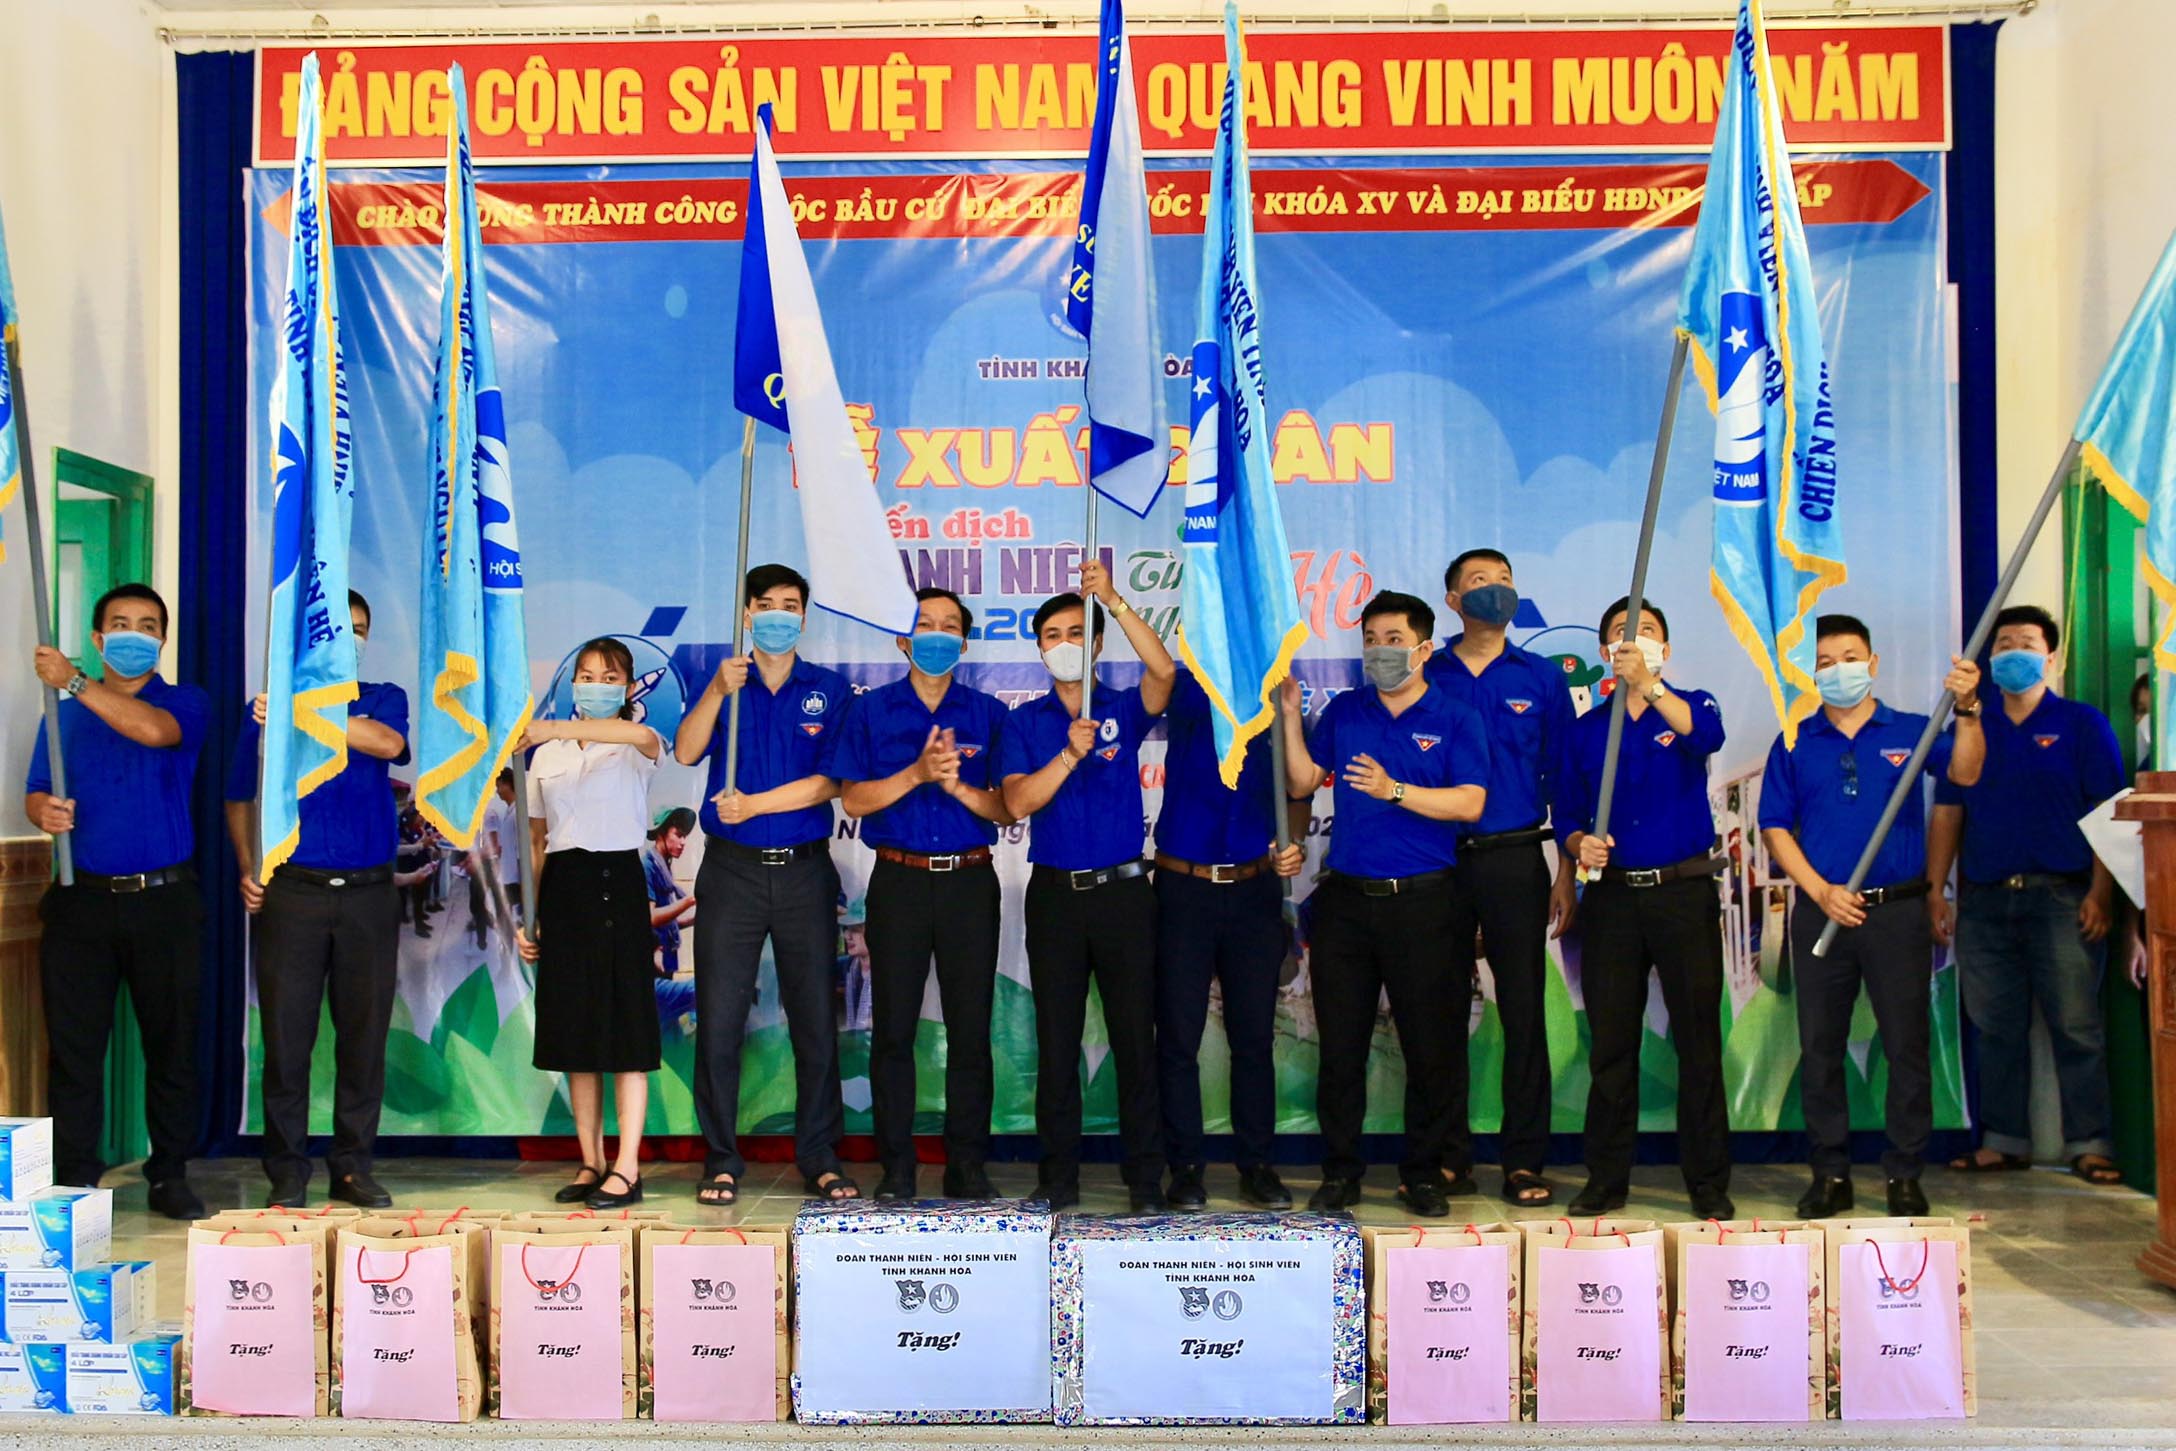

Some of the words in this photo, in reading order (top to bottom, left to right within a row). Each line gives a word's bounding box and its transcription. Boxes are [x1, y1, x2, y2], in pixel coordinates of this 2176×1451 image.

[475, 54, 643, 147] CỘNG
[668, 45, 797, 135] SẢN
[821, 52, 951, 142] VIỆT
[1147, 60, 1362, 138] QUANG
[1382, 59, 1532, 127] VINH
[1552, 42, 1731, 125] MUÔN
[1770, 41, 1919, 122] NĂM
[356, 198, 438, 229] CHÀO
[543, 197, 647, 227] THÀNH
[655, 194, 738, 225] CÔNG
[789, 194, 827, 228] ỘC
[834, 187, 898, 222] BẦU
[1147, 183, 1191, 217] ỐC
[1264, 185, 1348, 215] KHÓA
[1356, 191, 1399, 214] XV
[1407, 184, 1448, 213] VÀ
[1456, 189, 1513, 220] ĐẠI
[1796, 173, 1833, 207] ẤP
[1164, 354, 1193, 376] ÒA
[1792, 435, 1837, 523] CHIẾN
[942, 509, 1031, 546] dịch
[489, 559, 514, 578] HỘI
[869, 1254, 904, 1262] THANH
[965, 1254, 990, 1262] SINH
[1152, 1261, 1188, 1269] THANH
[1248, 1261, 1274, 1269] SINH
[897, 1331, 961, 1352] Tặng!
[1180, 1338, 1244, 1360] Tặng!
[230, 1343, 274, 1358] Tặng!
[373, 1348, 415, 1363] Tặng!
[537, 1344, 582, 1358] Tặng!
[691, 1344, 736, 1359] Tặng!
[1426, 1346, 1470, 1361] Tặng!
[1576, 1346, 1622, 1361] Tặng!
[1725, 1345, 1769, 1360] Tặng!
[1880, 1343, 1922, 1359] Tặng!
